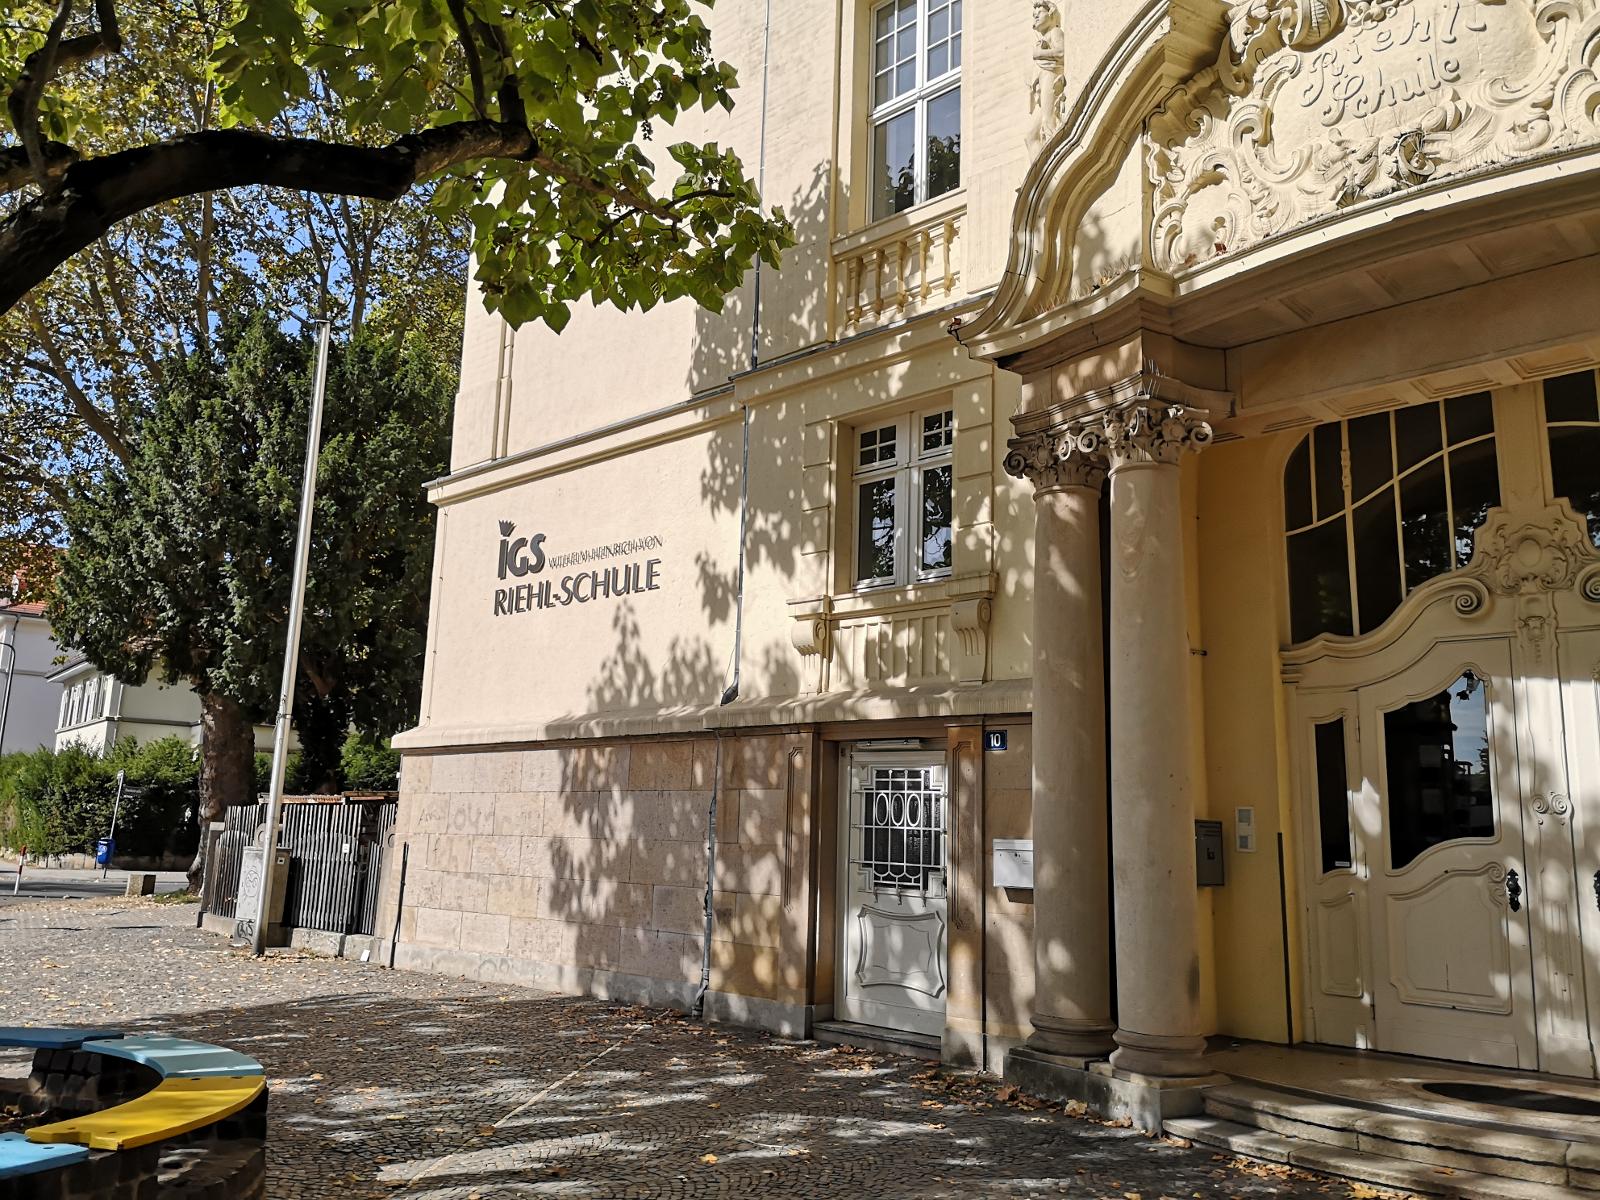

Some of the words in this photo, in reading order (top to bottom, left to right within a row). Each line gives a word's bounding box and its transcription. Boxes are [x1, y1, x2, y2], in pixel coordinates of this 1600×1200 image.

[1320, 52, 1461, 127] Schule
[493, 558, 662, 616] RIEHL-SCHULE
[990, 733, 1001, 747] 10
